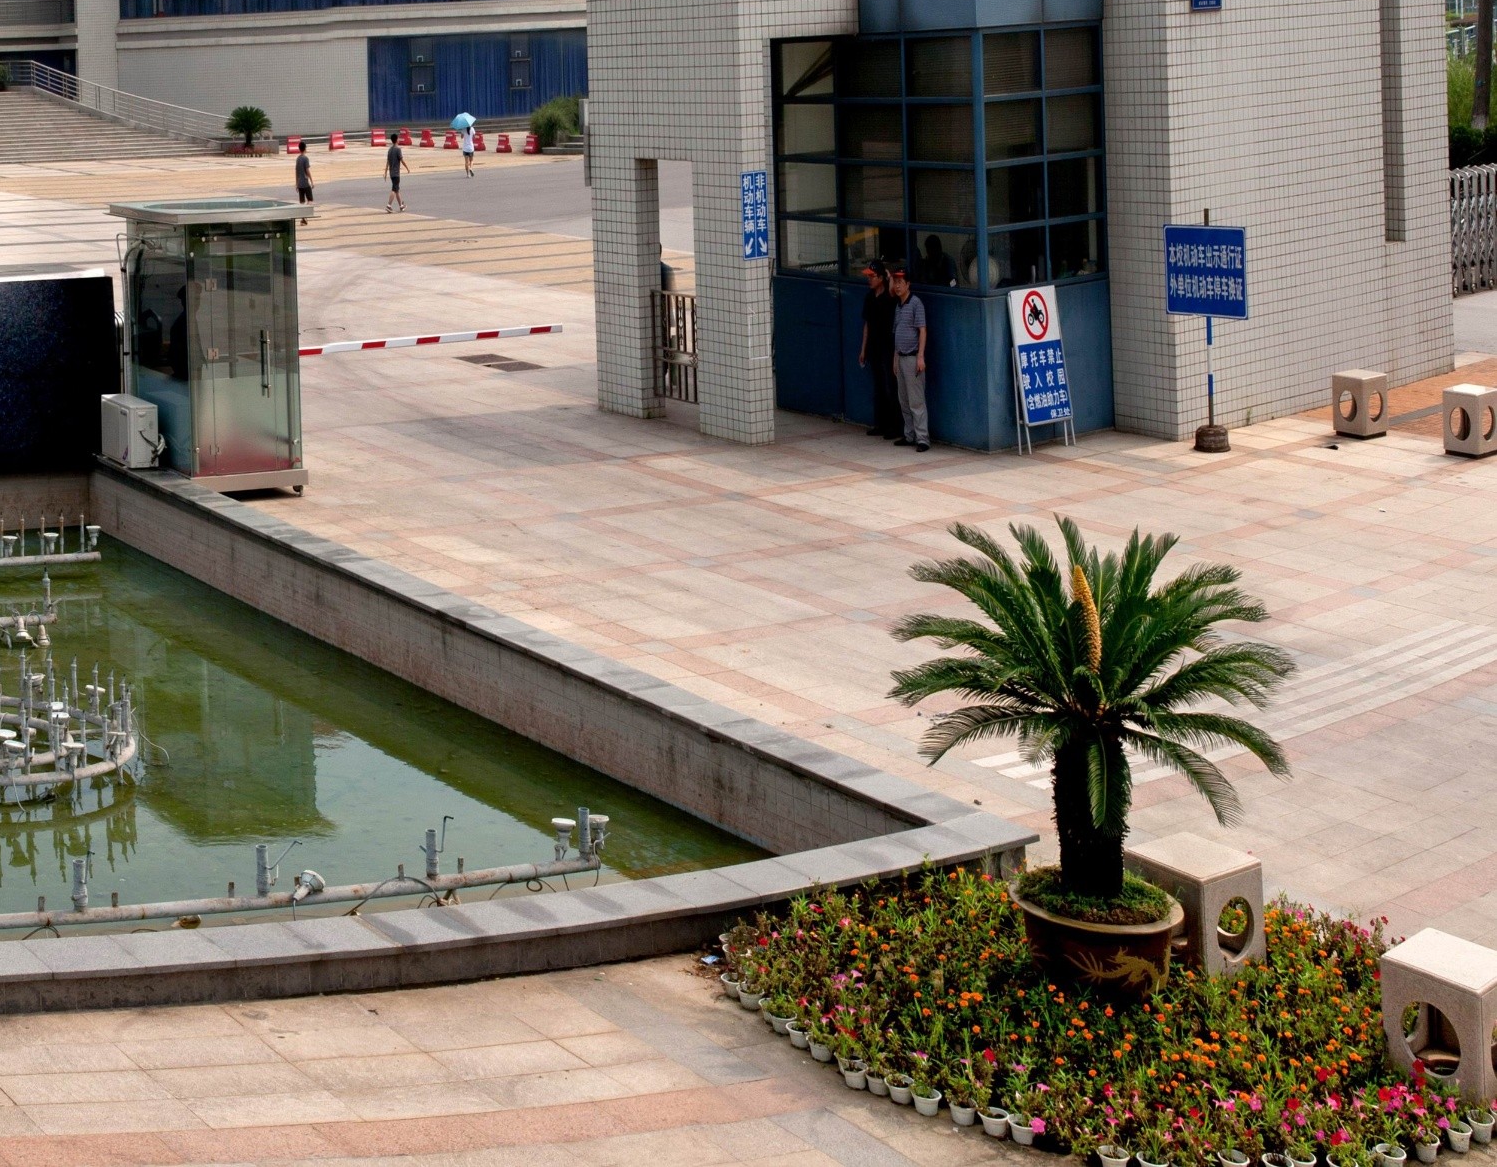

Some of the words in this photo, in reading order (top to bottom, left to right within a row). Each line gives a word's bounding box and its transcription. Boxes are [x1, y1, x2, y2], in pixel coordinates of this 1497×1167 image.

[743, 175, 755, 233] 机动车辆
[755, 173, 767, 232] 非机动车
[1169, 242, 1242, 269] 本校机动车出示通行证
[1020, 348, 1063, 368] 摩托车禁止
[1022, 369, 1065, 390] 驶入校园
[1051, 407, 1071, 419] 保卫处
